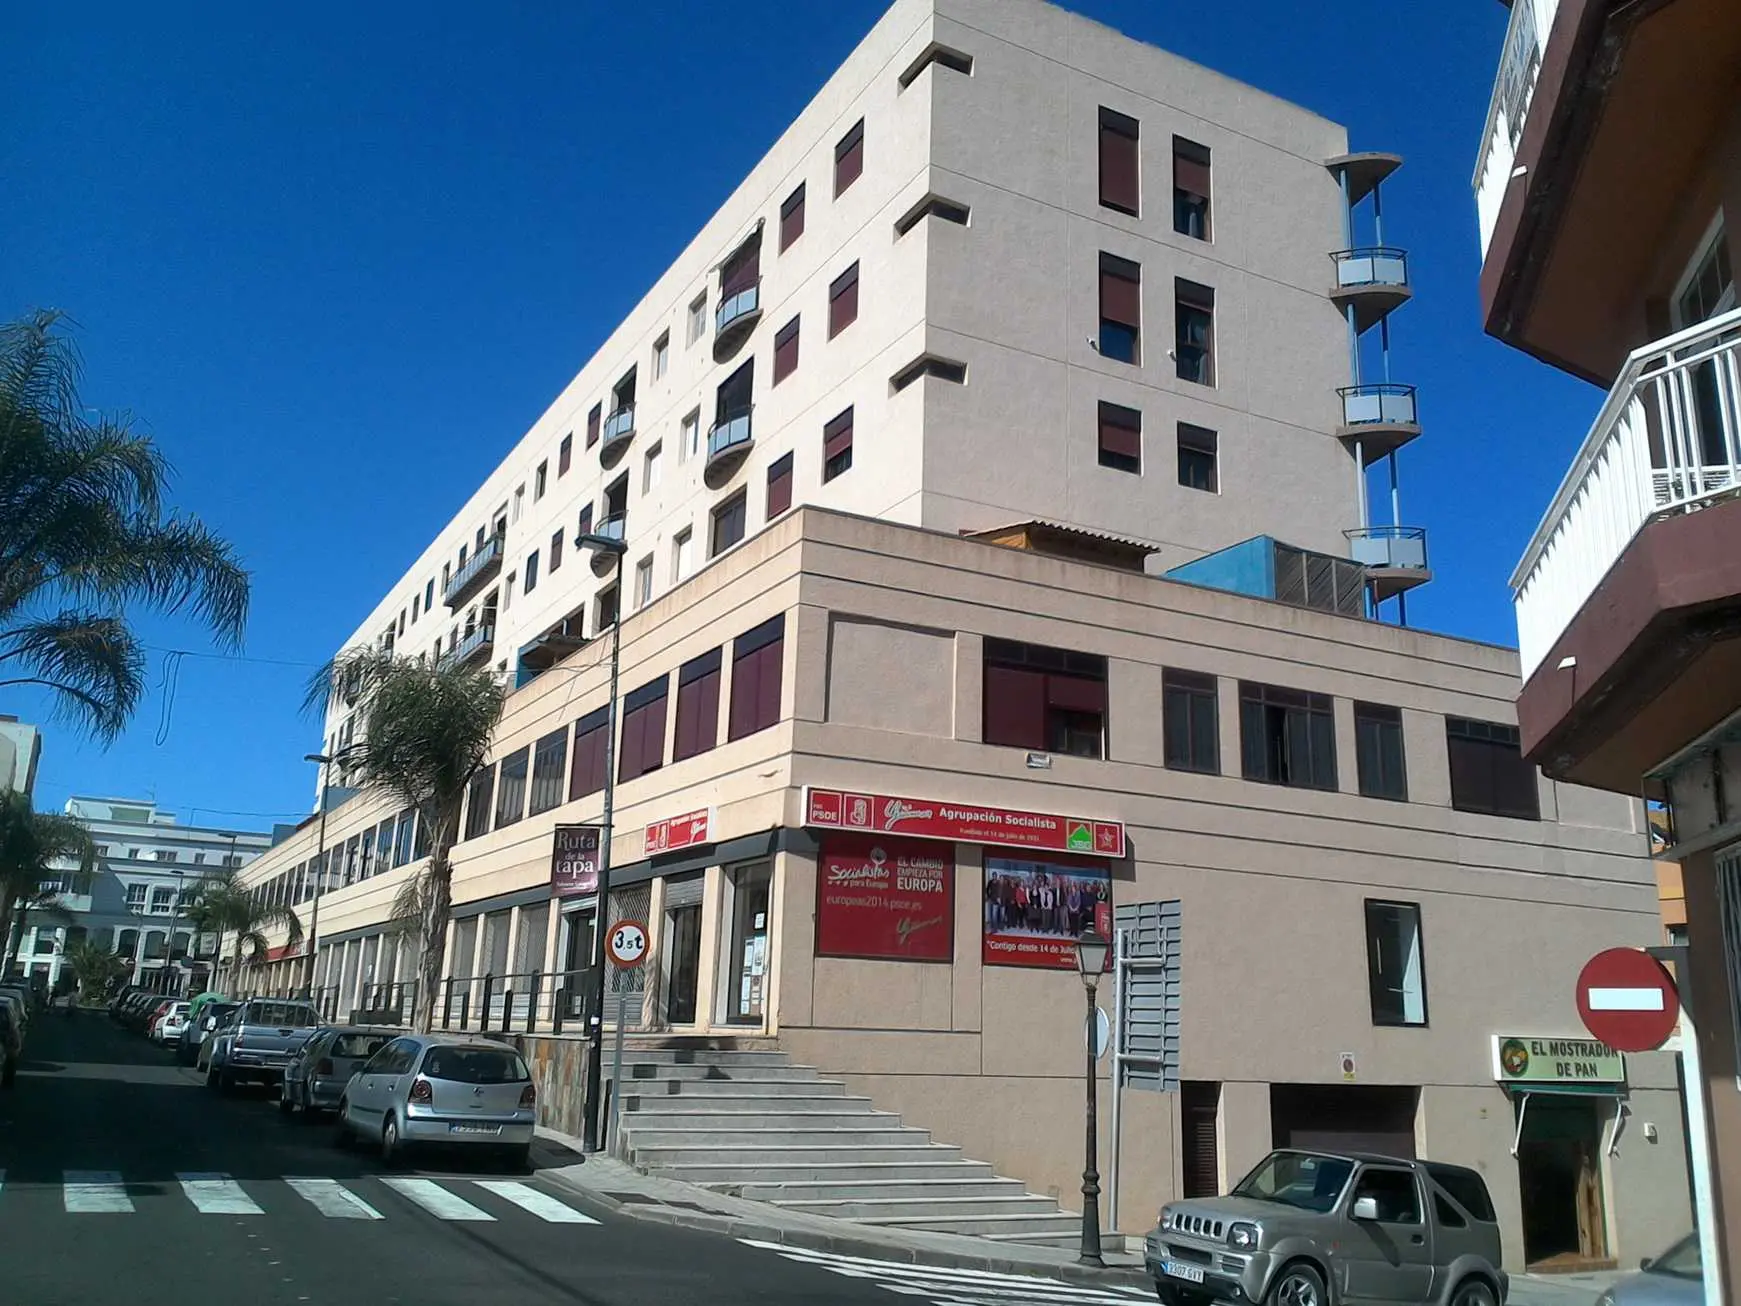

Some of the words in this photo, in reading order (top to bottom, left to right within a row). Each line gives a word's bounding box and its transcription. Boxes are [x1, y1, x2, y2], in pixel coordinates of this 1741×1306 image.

[812, 810, 838, 821] PSOE
[939, 807, 1002, 824] Agrupación
[1005, 815, 1057, 830] Socialista
[556, 831, 595, 851] Ruta
[564, 852, 575, 861] de
[577, 852, 585, 860] la
[897, 856, 909, 867] EL
[910, 857, 944, 869] CAMBIO
[556, 860, 594, 879] tapa
[828, 863, 890, 880] Socialistas
[897, 867, 928, 878] EMPIEZA
[928, 869, 944, 879] POR
[897, 877, 944, 893] EUROPA
[1017, 944, 1038, 953] desde
[1040, 944, 1049, 953] 14
[1050, 945, 1059, 953] de
[1531, 1041, 1547, 1056] EL
[1549, 1041, 1619, 1058] MOSTRADOR
[1556, 1062, 1573, 1077] DE
[1575, 1062, 1599, 1077] PAN
